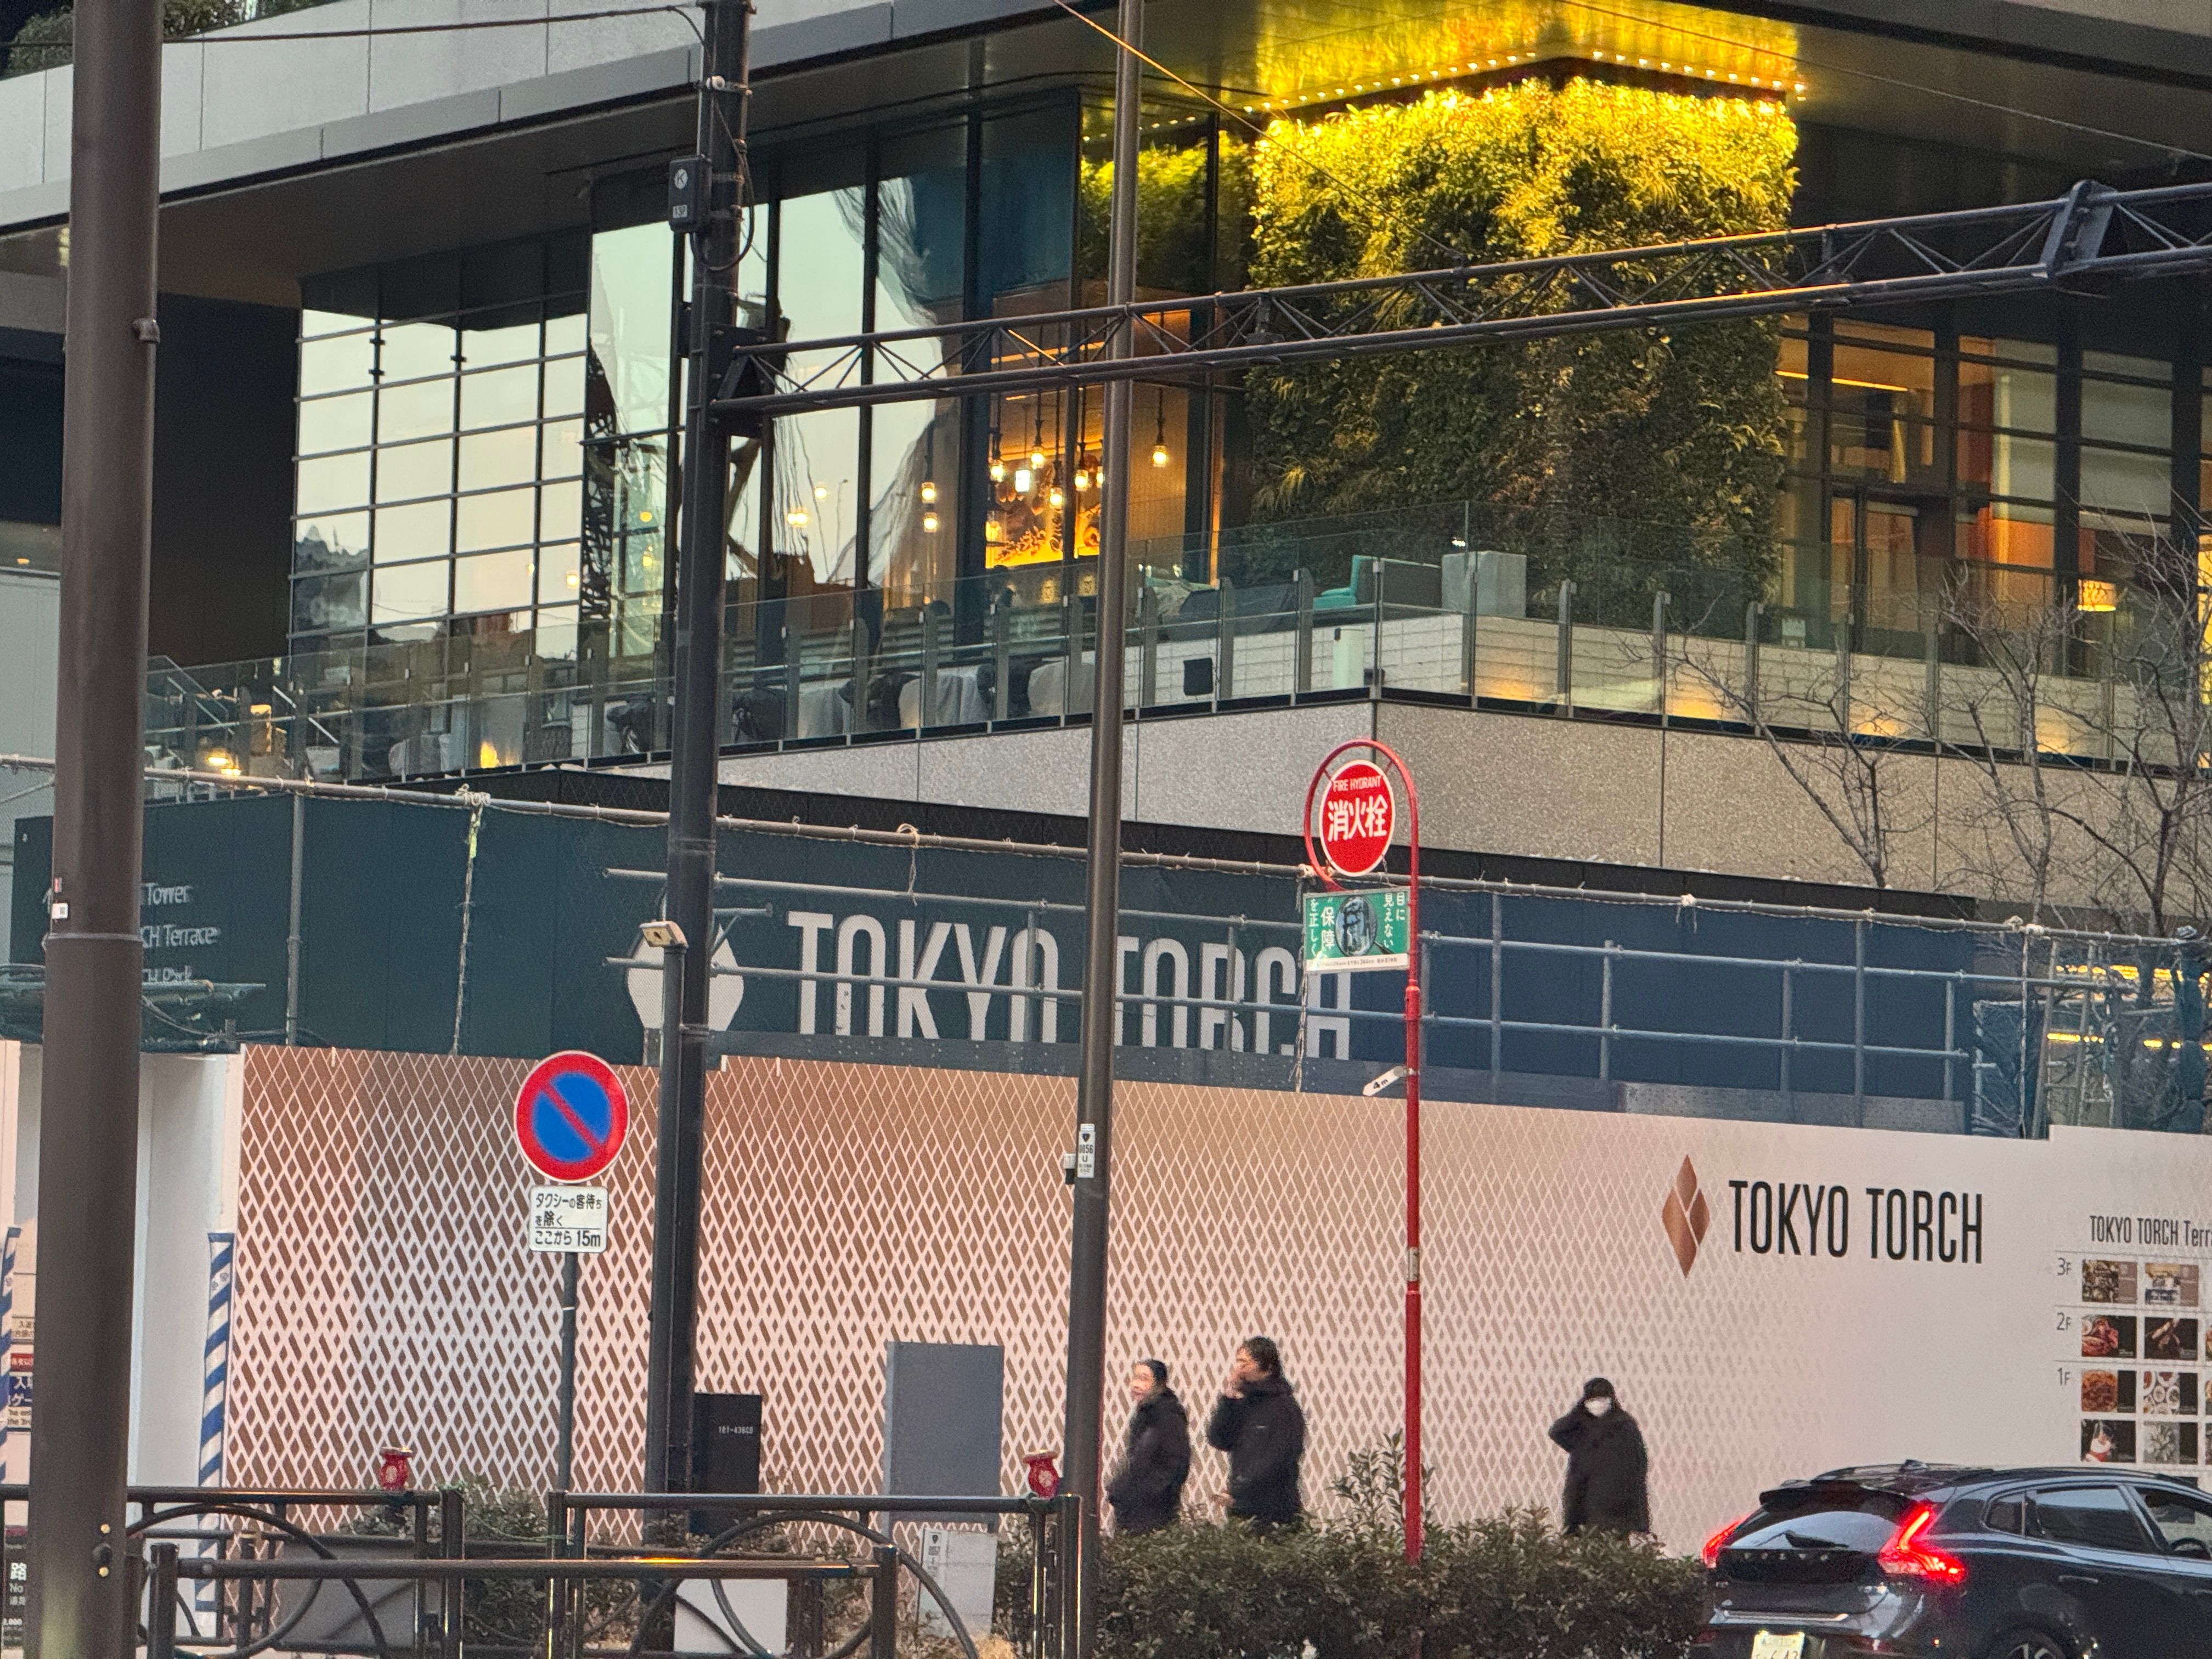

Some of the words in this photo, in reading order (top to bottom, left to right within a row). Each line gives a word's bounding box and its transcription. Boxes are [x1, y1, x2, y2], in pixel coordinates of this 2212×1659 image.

[1333, 779, 1348, 792] FIRE
[1350, 775, 1381, 790] HYDRANT
[1328, 794, 1389, 842] 消火栓
[1396, 892, 1405, 921] 目に
[1383, 893, 1394, 949] 見えない
[163, 924, 221, 947] Terrace
[536, 1193, 602, 1210] タクシーの客待ち
[535, 1210, 563, 1226] を除く
[1728, 1180, 1849, 1257] TOKYO
[1865, 1188, 1983, 1263] TORCH
[535, 1231, 572, 1245] ここから
[577, 1230, 601, 1246] 15m
[2090, 1215, 2132, 1244] TOKYO
[2137, 1218, 2179, 1246] TORCH
[2183, 1220, 2212, 1247] Terr
[2057, 1257, 2072, 1276] 3F
[2057, 1312, 2072, 1331] 2F
[2057, 1367, 2070, 1386] 1F
